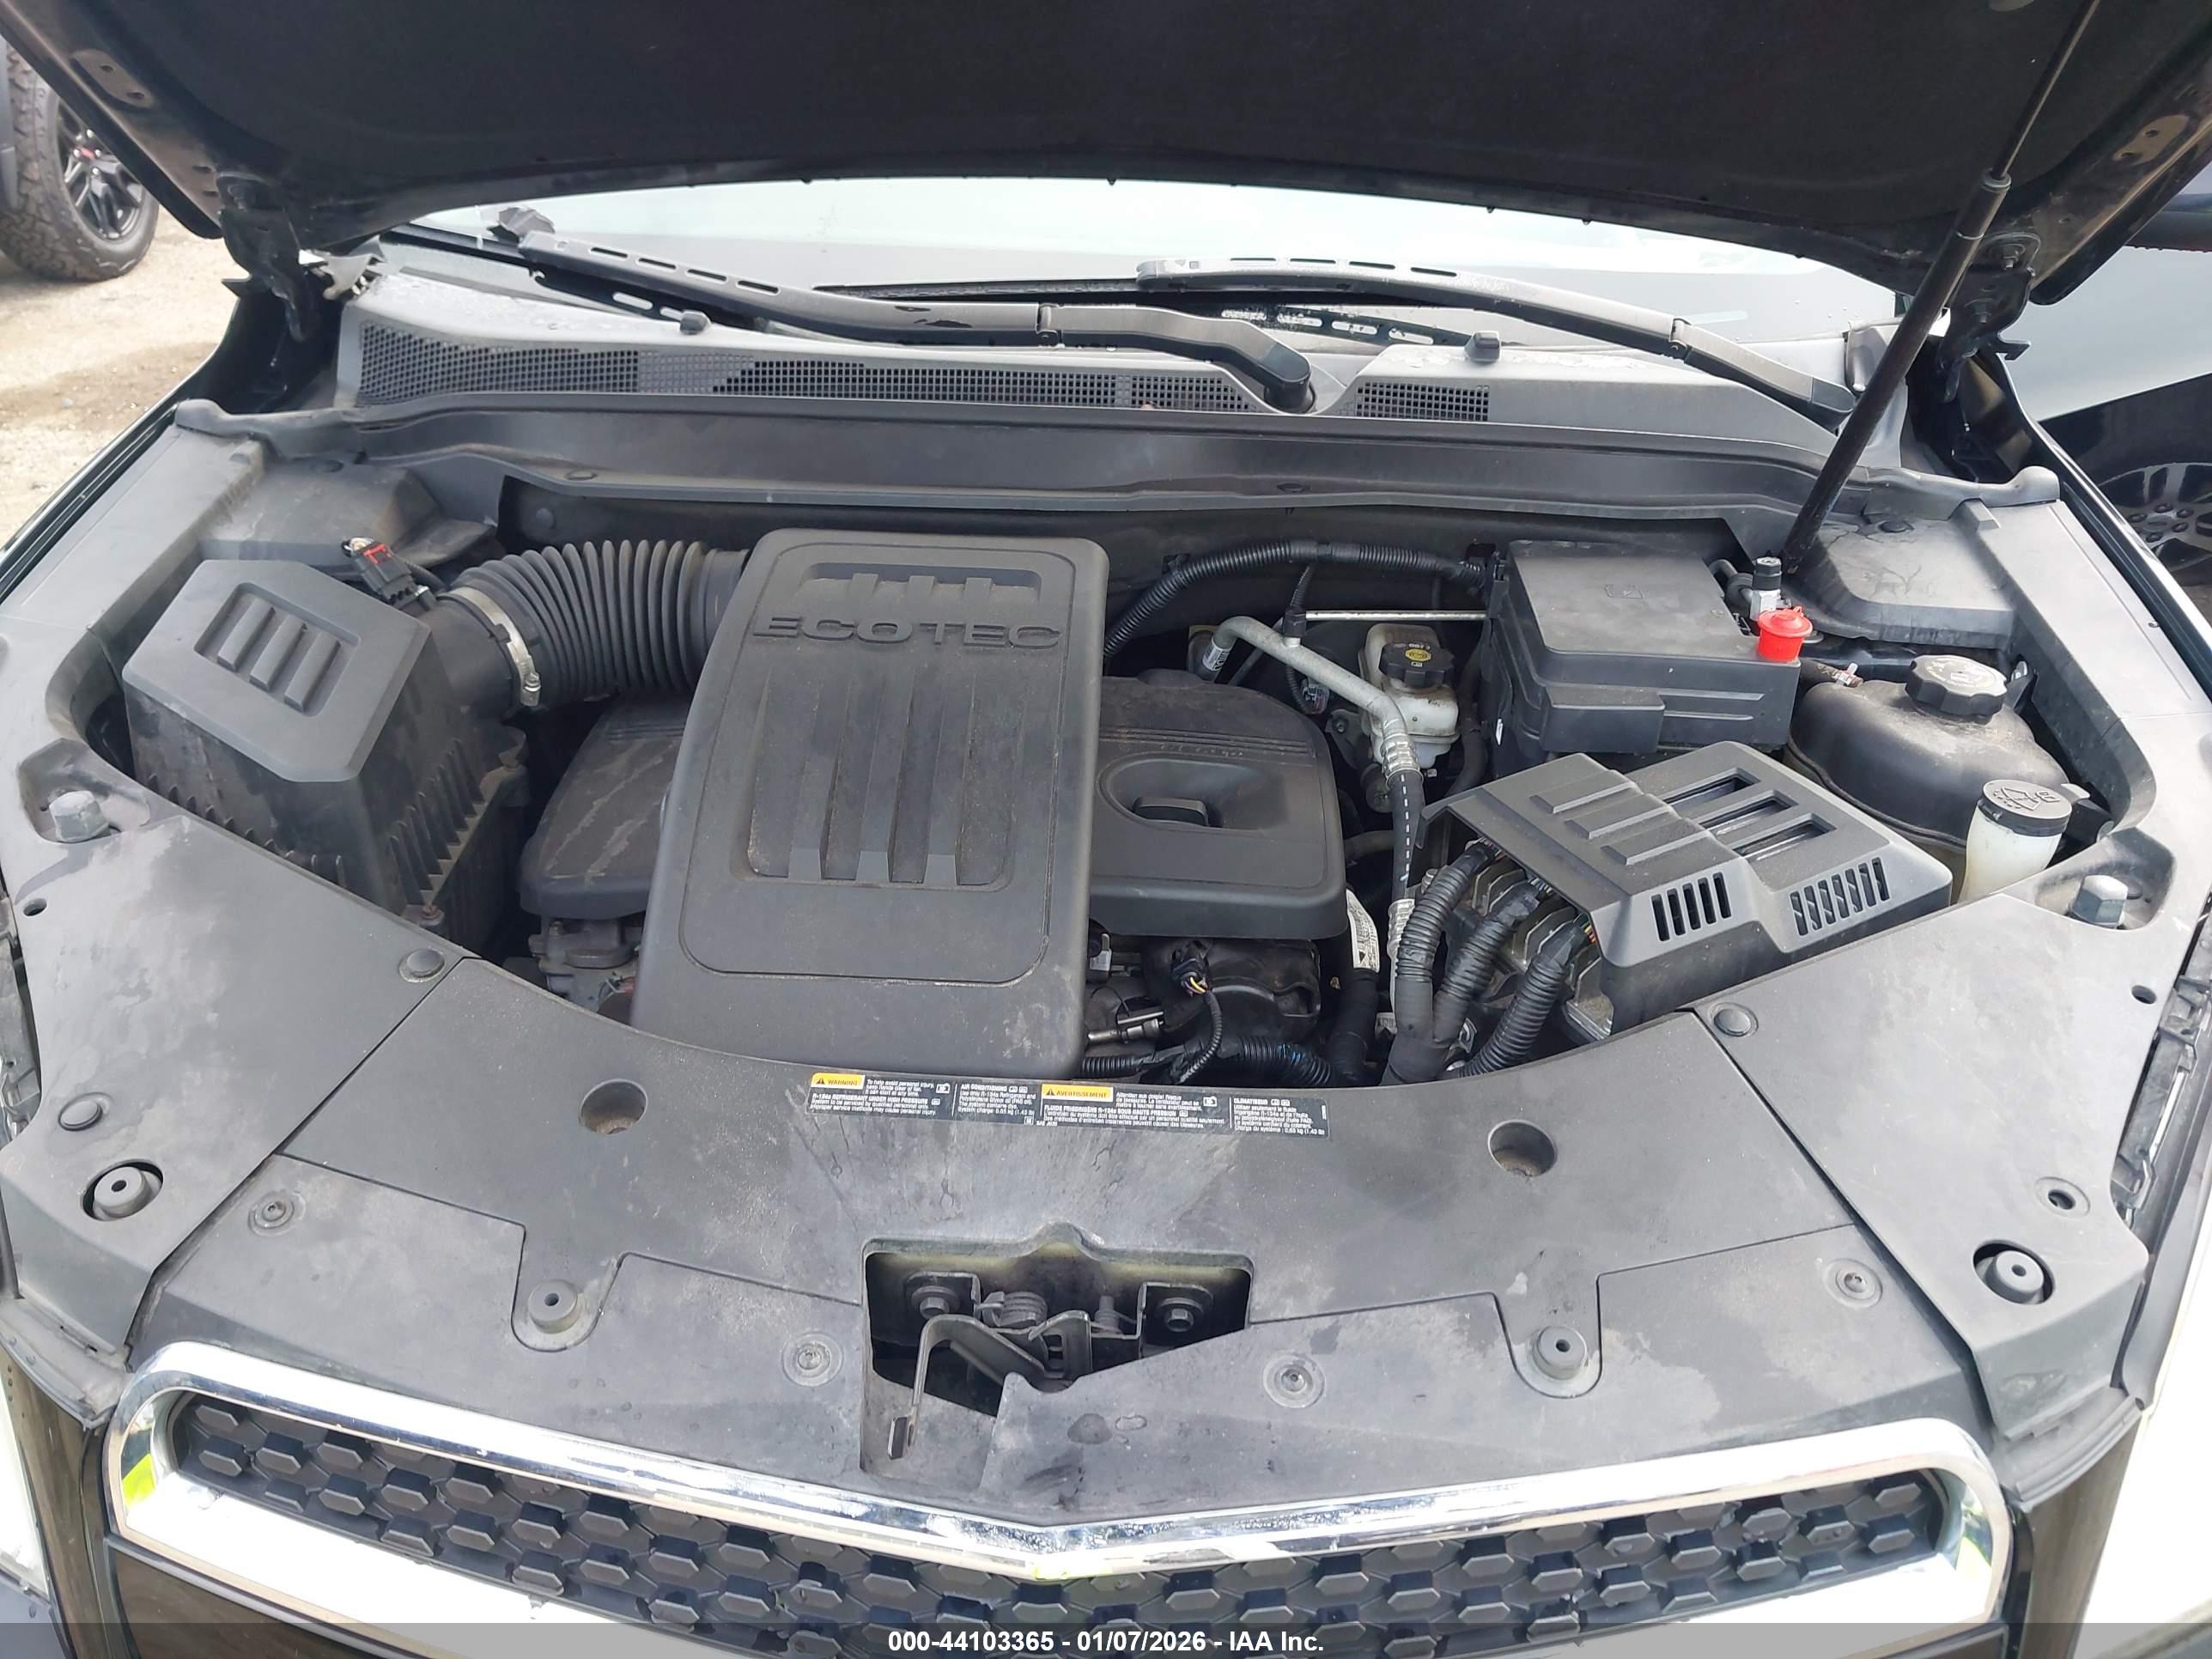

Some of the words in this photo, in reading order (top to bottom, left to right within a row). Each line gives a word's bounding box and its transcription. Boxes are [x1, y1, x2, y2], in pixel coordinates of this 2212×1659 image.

[752, 614, 1062, 650] ECOTEC
[828, 1078, 858, 1086] WARNING
[971, 1084, 1007, 1092] CONDITIONING
[1056, 1090, 1107, 1099] AVERTISSEMENT
